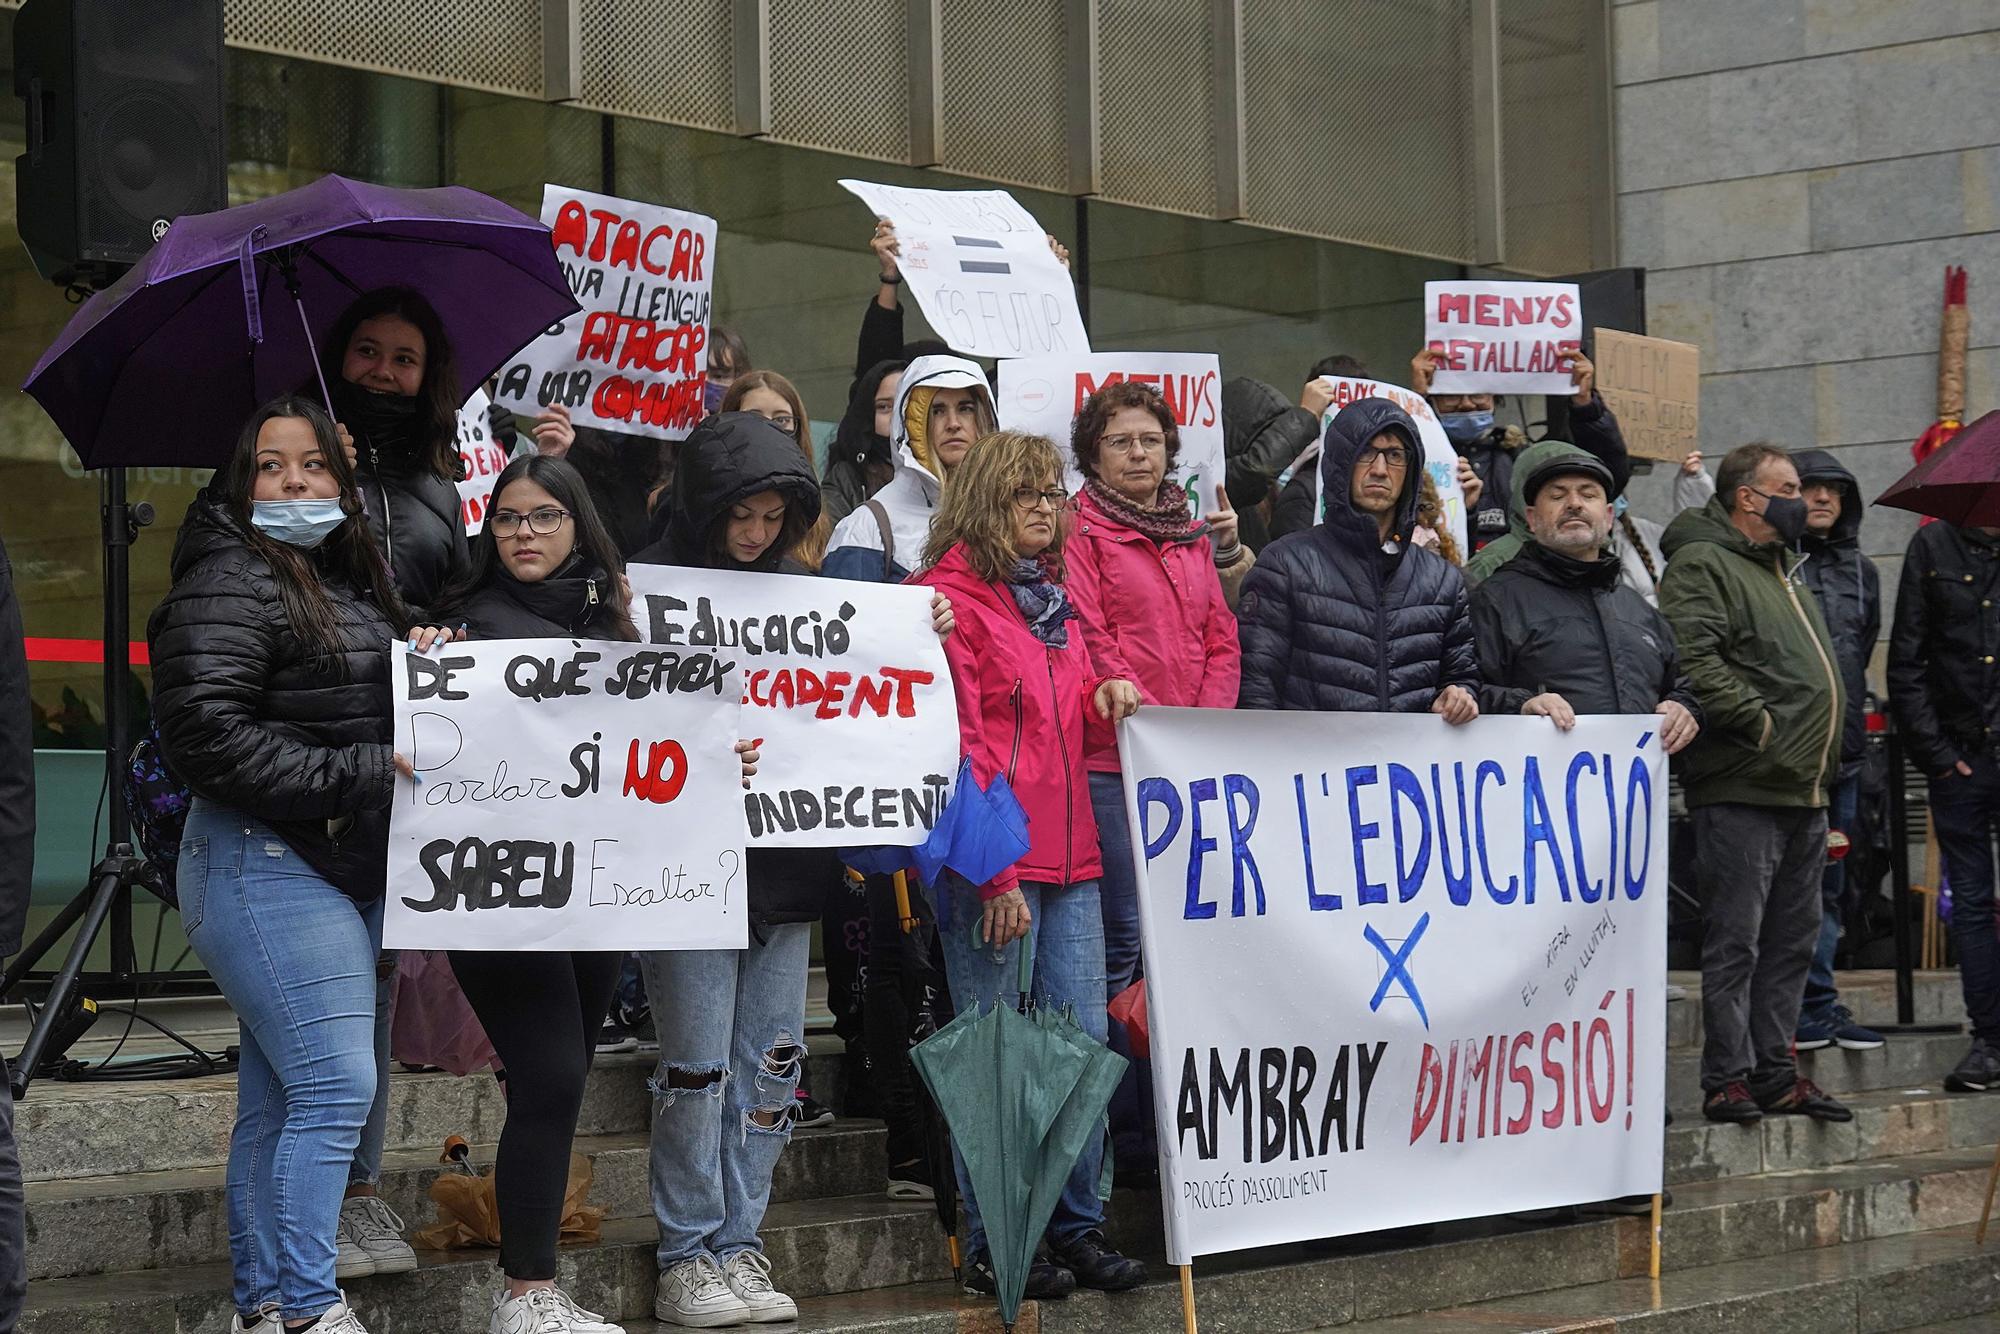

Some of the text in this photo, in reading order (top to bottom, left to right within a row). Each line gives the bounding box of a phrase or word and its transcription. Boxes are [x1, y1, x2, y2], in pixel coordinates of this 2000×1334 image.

[553, 199, 705, 282] ATACAR
[617, 276, 709, 326] LLENGUA
[1438, 293, 1574, 329] MENYS
[576, 311, 705, 379] ATACAR
[500, 363, 532, 400] A
[537, 368, 592, 407] UNA
[645, 594, 858, 660] Educació
[406, 652, 475, 701] DE
[504, 640, 601, 703] QUÈ
[411, 712, 557, 806] Parlar
[622, 738, 688, 805] NO
[1137, 731, 1654, 920] PER L'EDUCACIÓ
[401, 835, 574, 913] SABEU
[1176, 987, 1636, 1163] AMBRAY DIMISSIÓ!
[1183, 1171, 1235, 1210] PROCÉS
